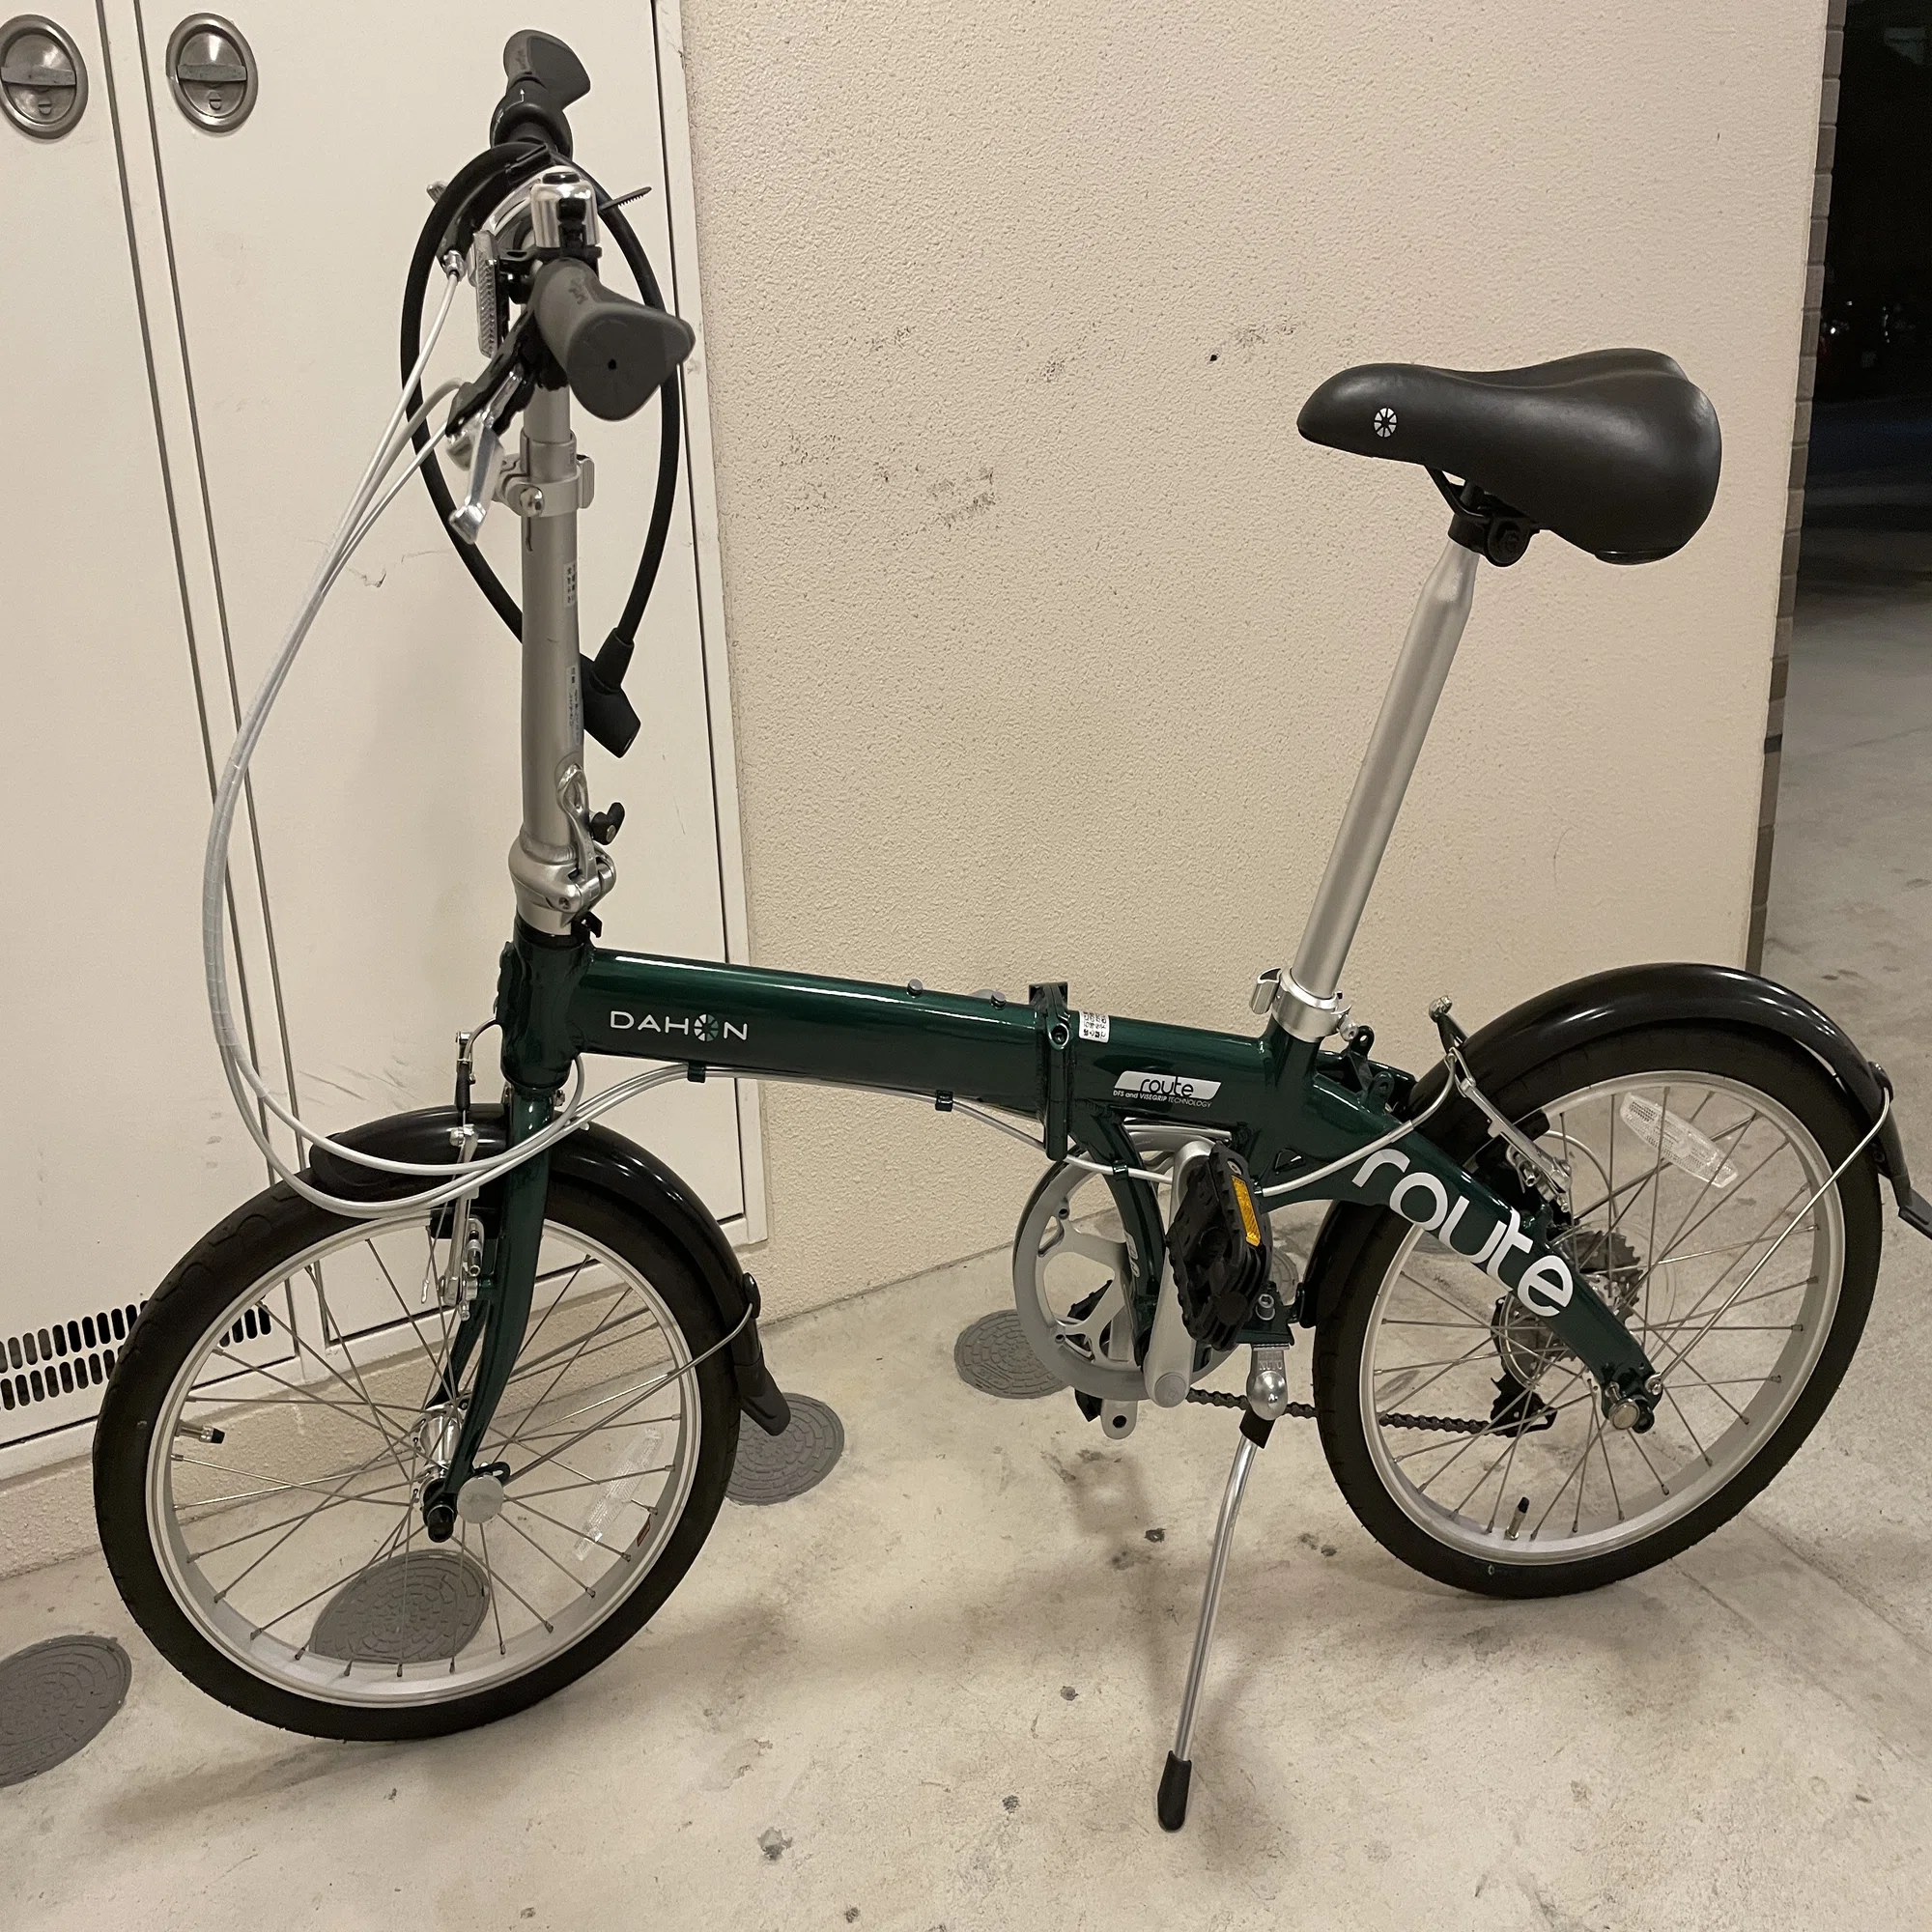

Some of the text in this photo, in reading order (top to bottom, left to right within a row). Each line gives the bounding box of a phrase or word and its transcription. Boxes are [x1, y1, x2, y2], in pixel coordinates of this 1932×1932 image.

[611, 1010, 748, 1041] DAHON
[1140, 1076, 1194, 1097] route
[1168, 1096, 1211, 1108] TECHNOLOGY
[1352, 1149, 1574, 1317] route
